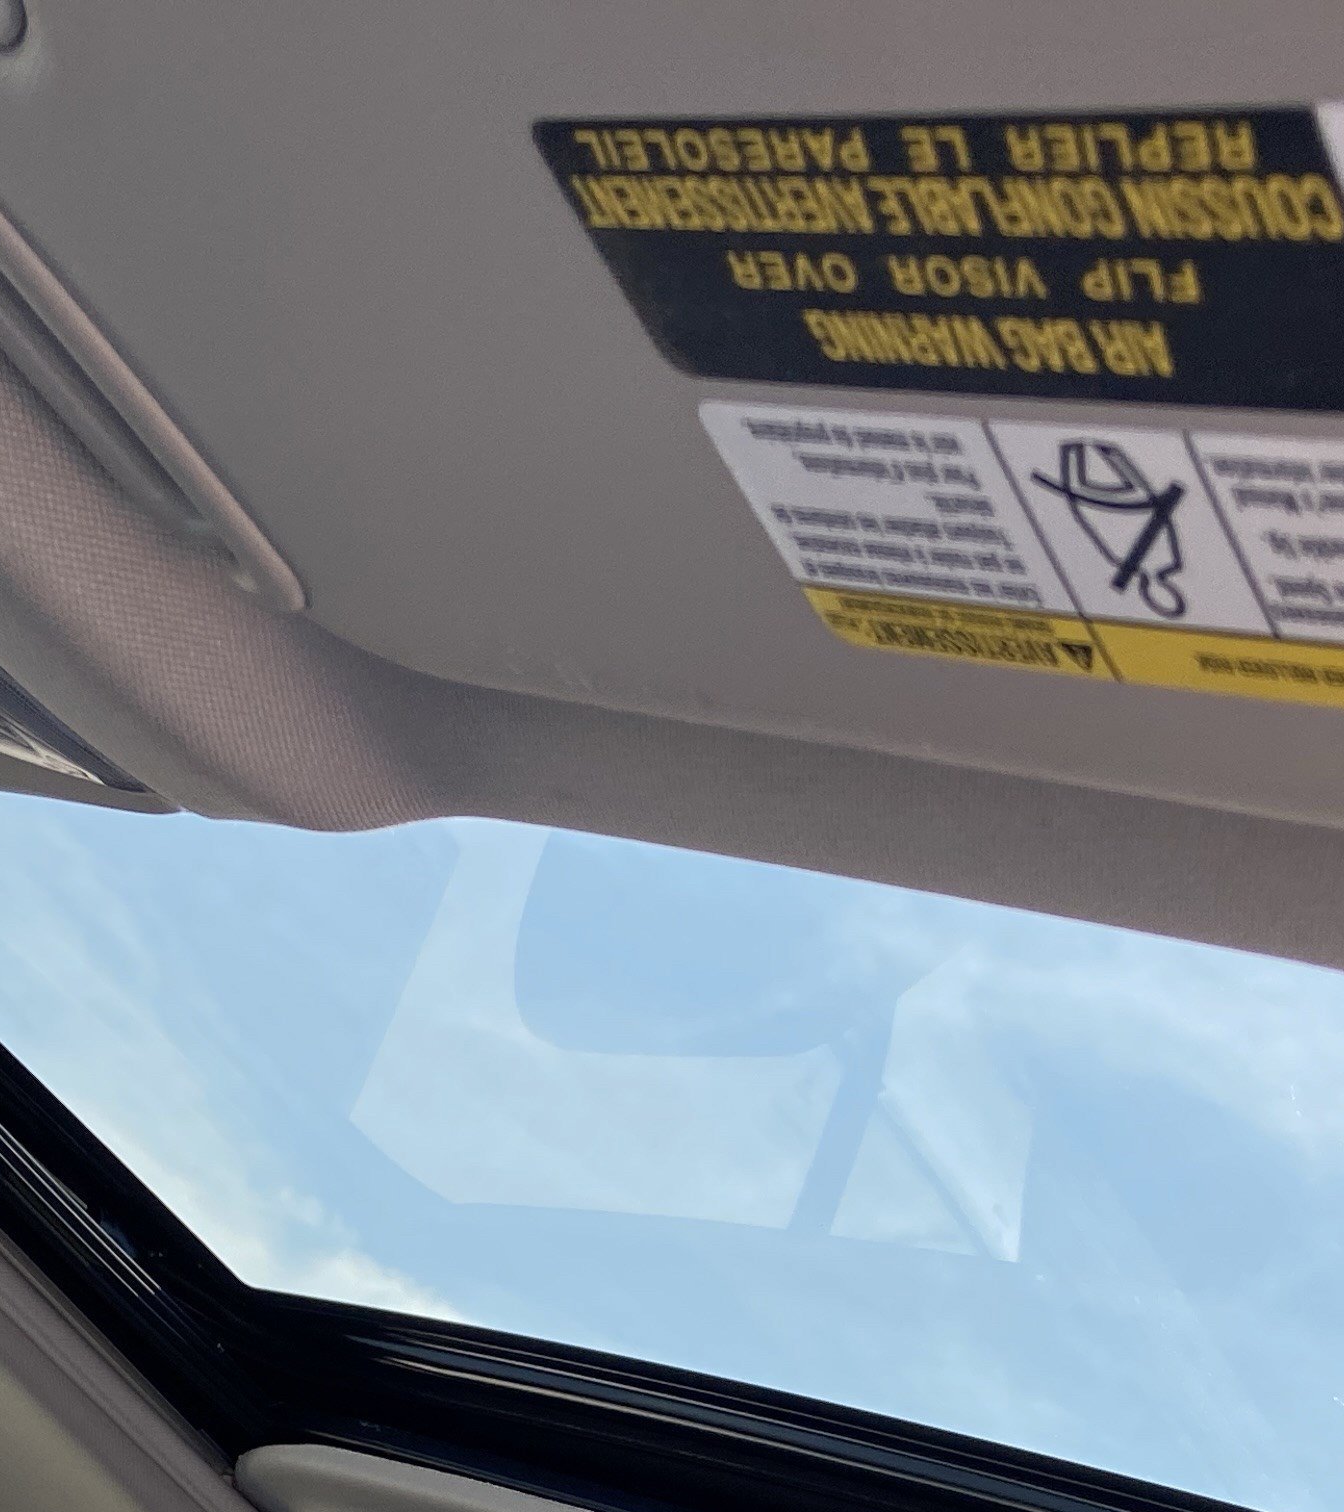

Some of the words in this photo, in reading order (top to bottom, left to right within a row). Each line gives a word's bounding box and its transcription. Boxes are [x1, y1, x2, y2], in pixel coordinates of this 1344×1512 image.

[572, 125, 870, 171] PARESOLEIL
[898, 124, 971, 171] LE
[1003, 119, 1255, 171] REPLIER
[569, 173, 875, 233] AVERTISSEMENT
[866, 174, 1125, 239] GONFLABLE
[1118, 171, 1344, 241] COUSSIN
[725, 248, 857, 294] OVER
[887, 254, 1047, 299] VISOR
[1080, 257, 1202, 302] FLIP
[802, 307, 1005, 369] WARNING
[993, 316, 1098, 374] BAG
[1088, 319, 1172, 377] AIR
